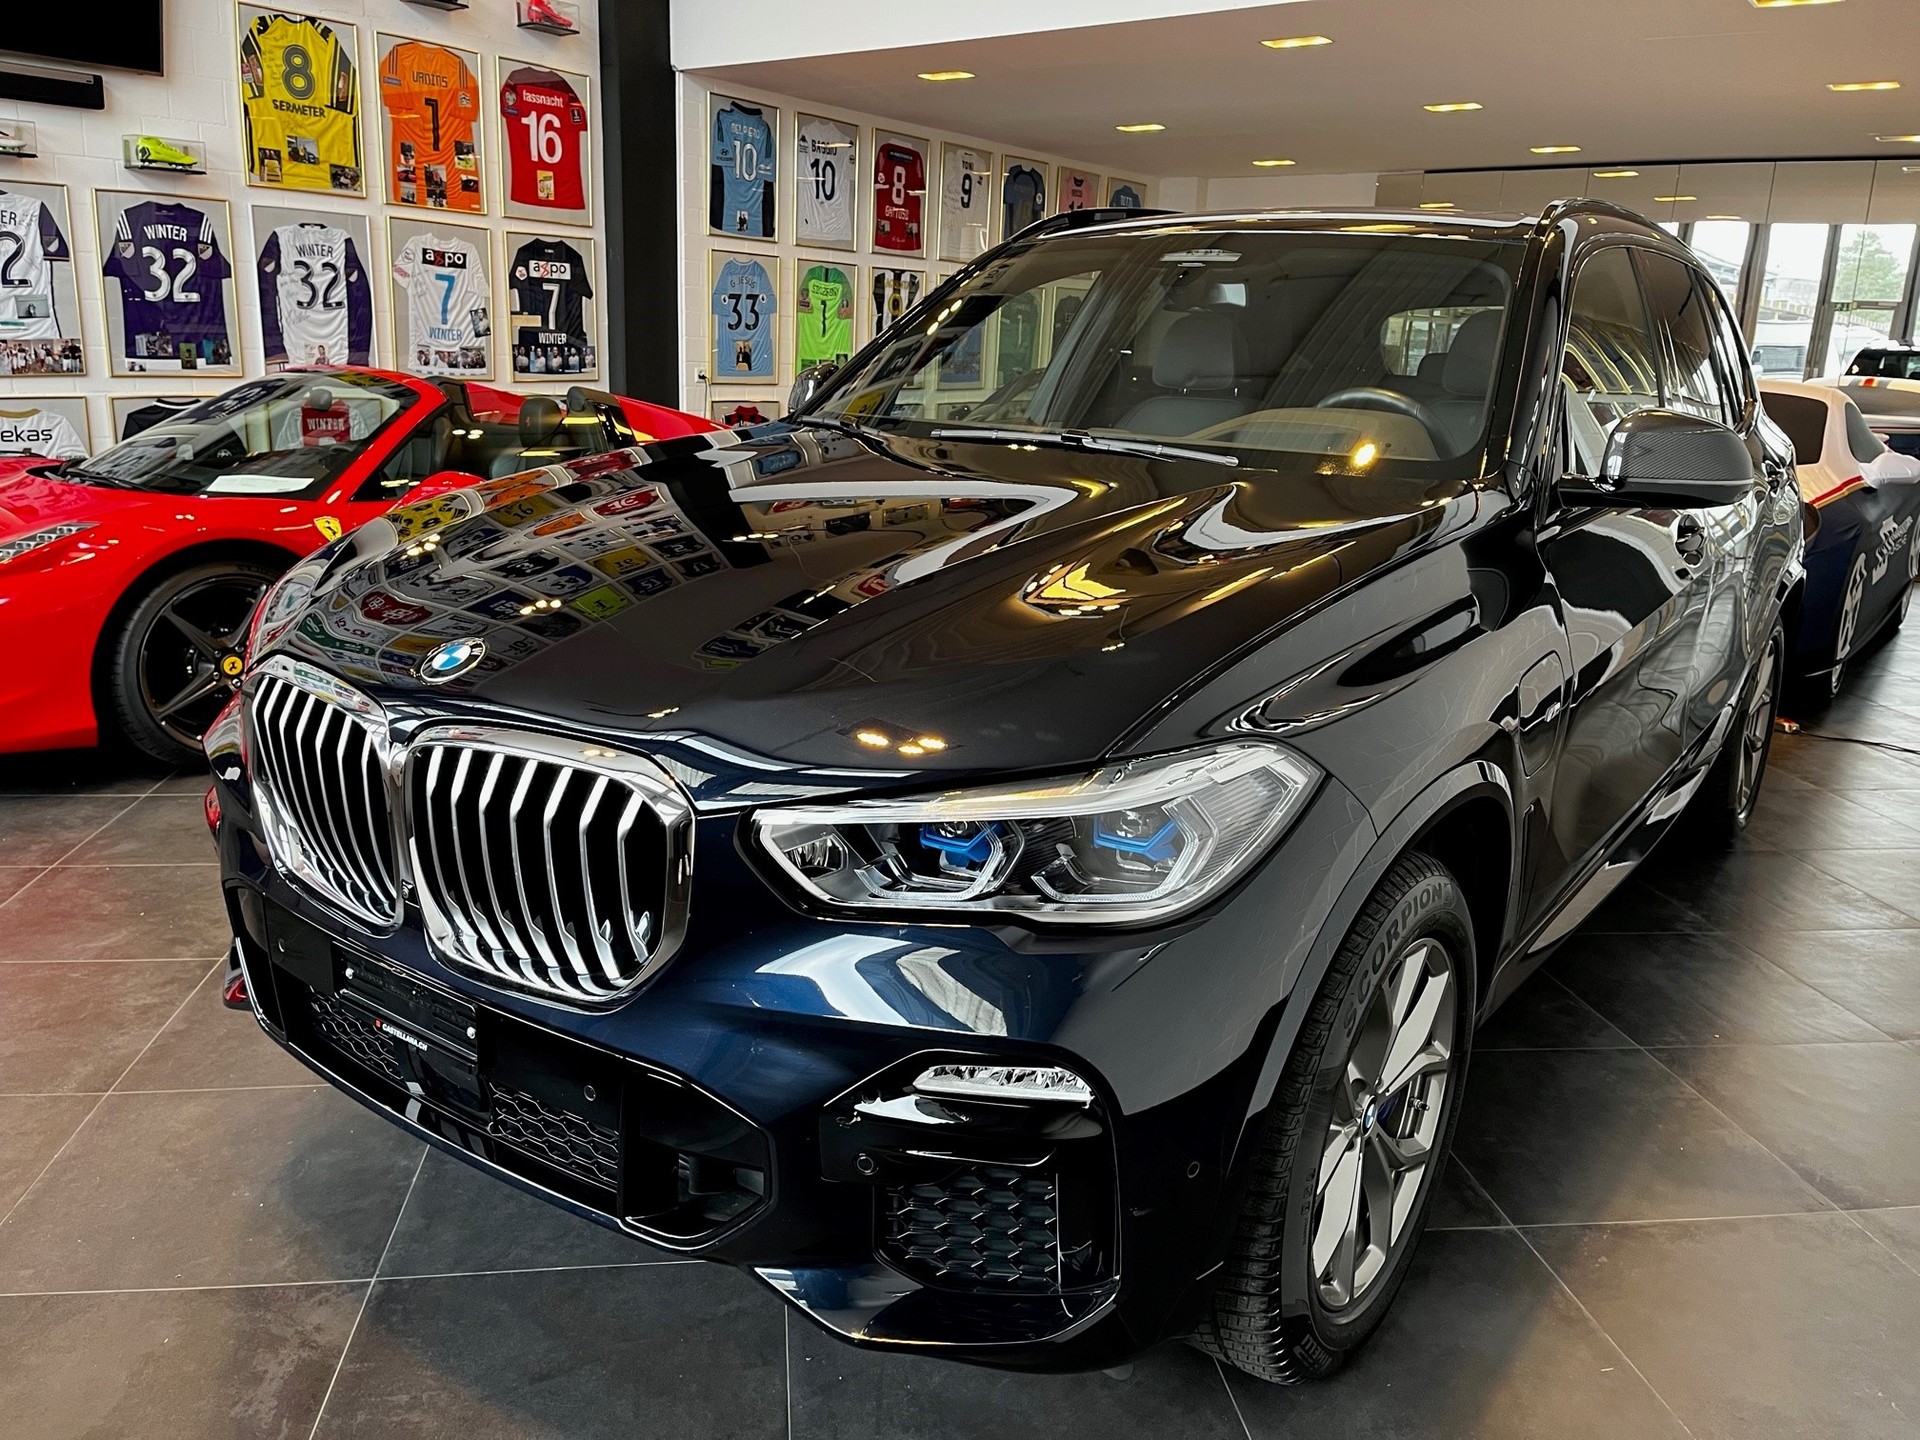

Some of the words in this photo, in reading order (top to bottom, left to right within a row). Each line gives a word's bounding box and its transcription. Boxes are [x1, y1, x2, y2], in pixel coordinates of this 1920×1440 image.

[282, 44, 316, 100] 8
[272, 99, 327, 119] SERMETER
[523, 89, 565, 108] fassnacht
[424, 97, 441, 152] 1
[521, 110, 563, 164] 16
[733, 138, 758, 182] 10
[810, 158, 837, 201] 10
[892, 165, 906, 206] 8
[961, 173, 973, 209] 9
[143, 224, 188, 243] WINTER
[295, 243, 335, 259] WINTER
[142, 246, 201, 303] 32
[294, 260, 346, 311] 32
[435, 273, 457, 326] 7
[542, 282, 562, 331] 7
[727, 293, 761, 331] 33
[429, 326, 464, 342] WINTER
[538, 332, 568, 345] WINTER
[306, 417, 346, 432] WINTER
[1343, 881, 1444, 1039] SCORPION
